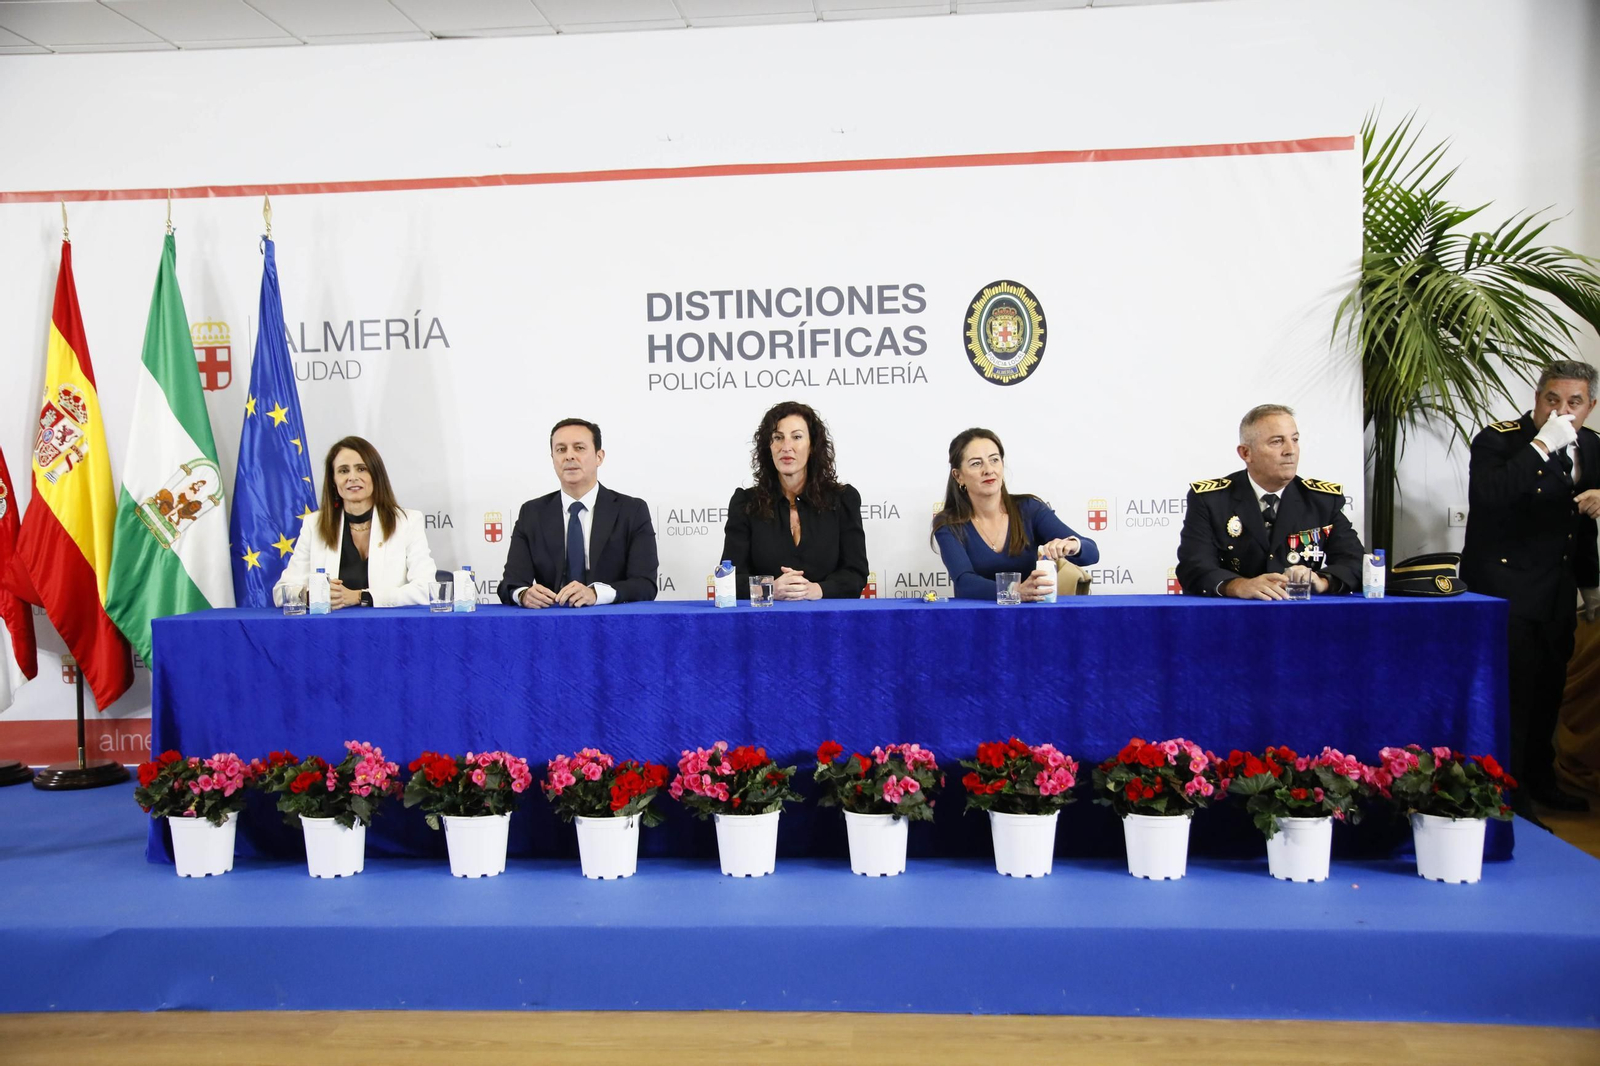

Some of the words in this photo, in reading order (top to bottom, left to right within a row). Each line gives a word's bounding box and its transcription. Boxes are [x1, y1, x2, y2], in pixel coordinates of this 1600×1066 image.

[647, 283, 927, 322] DISTINCIONES
[648, 321, 928, 363] HONORÍFICAS
[294, 360, 362, 382] UDAD
[649, 367, 737, 391] POLICÍA
[745, 369, 820, 388] LOCAL
[826, 362, 928, 386] ALMERÍA
[667, 508, 729, 523] ALMER
[860, 500, 901, 519] ERÍA
[1126, 499, 1187, 514] ALME
[667, 526, 709, 536] CIUDAD
[1126, 517, 1170, 527] CIUDAD
[895, 572, 951, 587] ALME
[1090, 566, 1133, 584] ERÍA
[99, 728, 152, 751] alme
